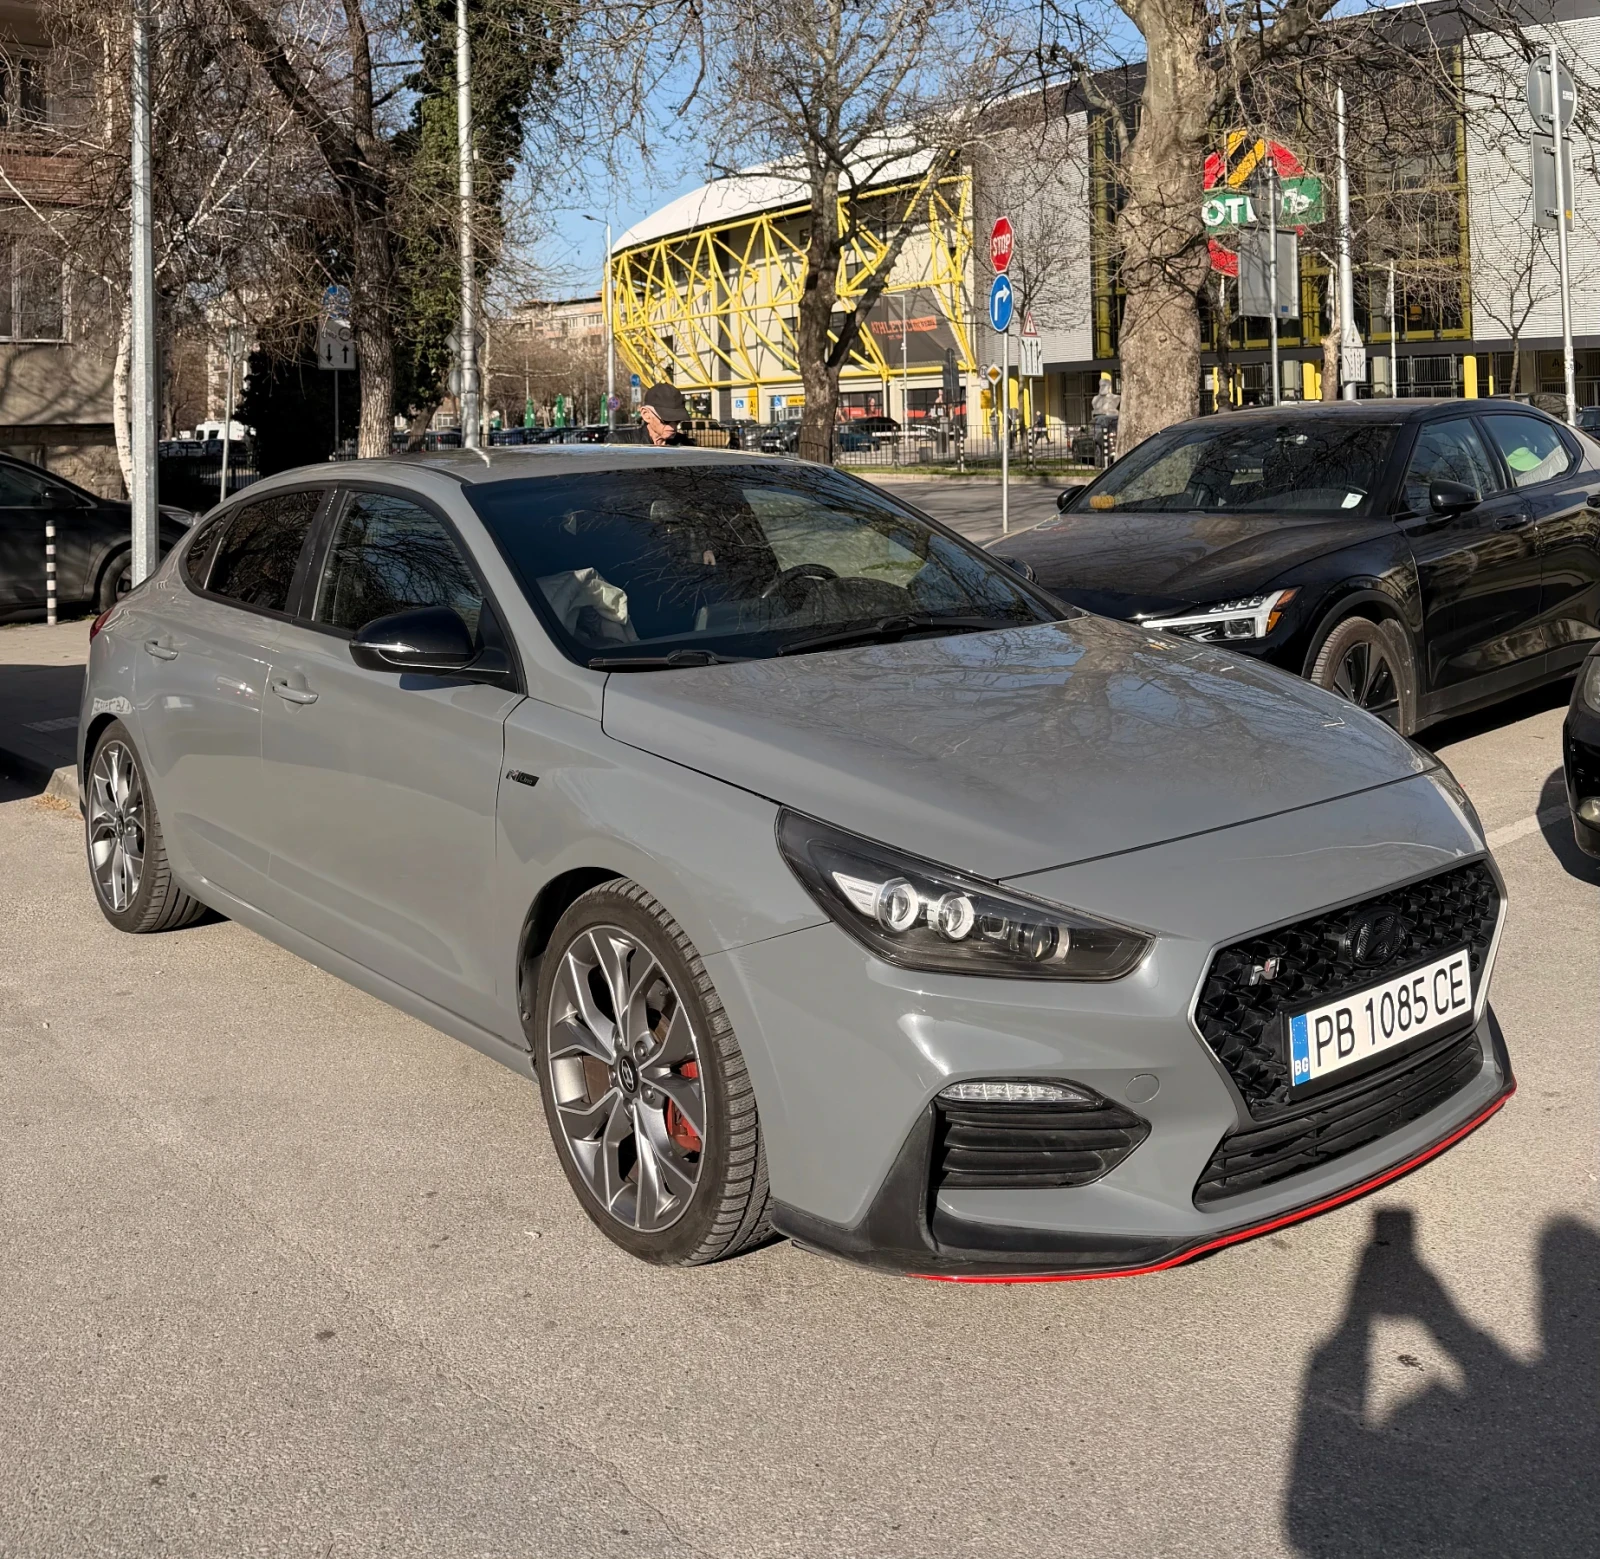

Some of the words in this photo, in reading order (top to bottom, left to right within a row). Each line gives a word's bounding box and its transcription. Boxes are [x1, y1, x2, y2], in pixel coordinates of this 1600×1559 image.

[992, 233, 1011, 257] STOP
[1314, 1007, 1355, 1068] PB
[1365, 975, 1428, 1046] 1085
[1433, 959, 1466, 1016] CE
[1294, 1057, 1309, 1077] BG
